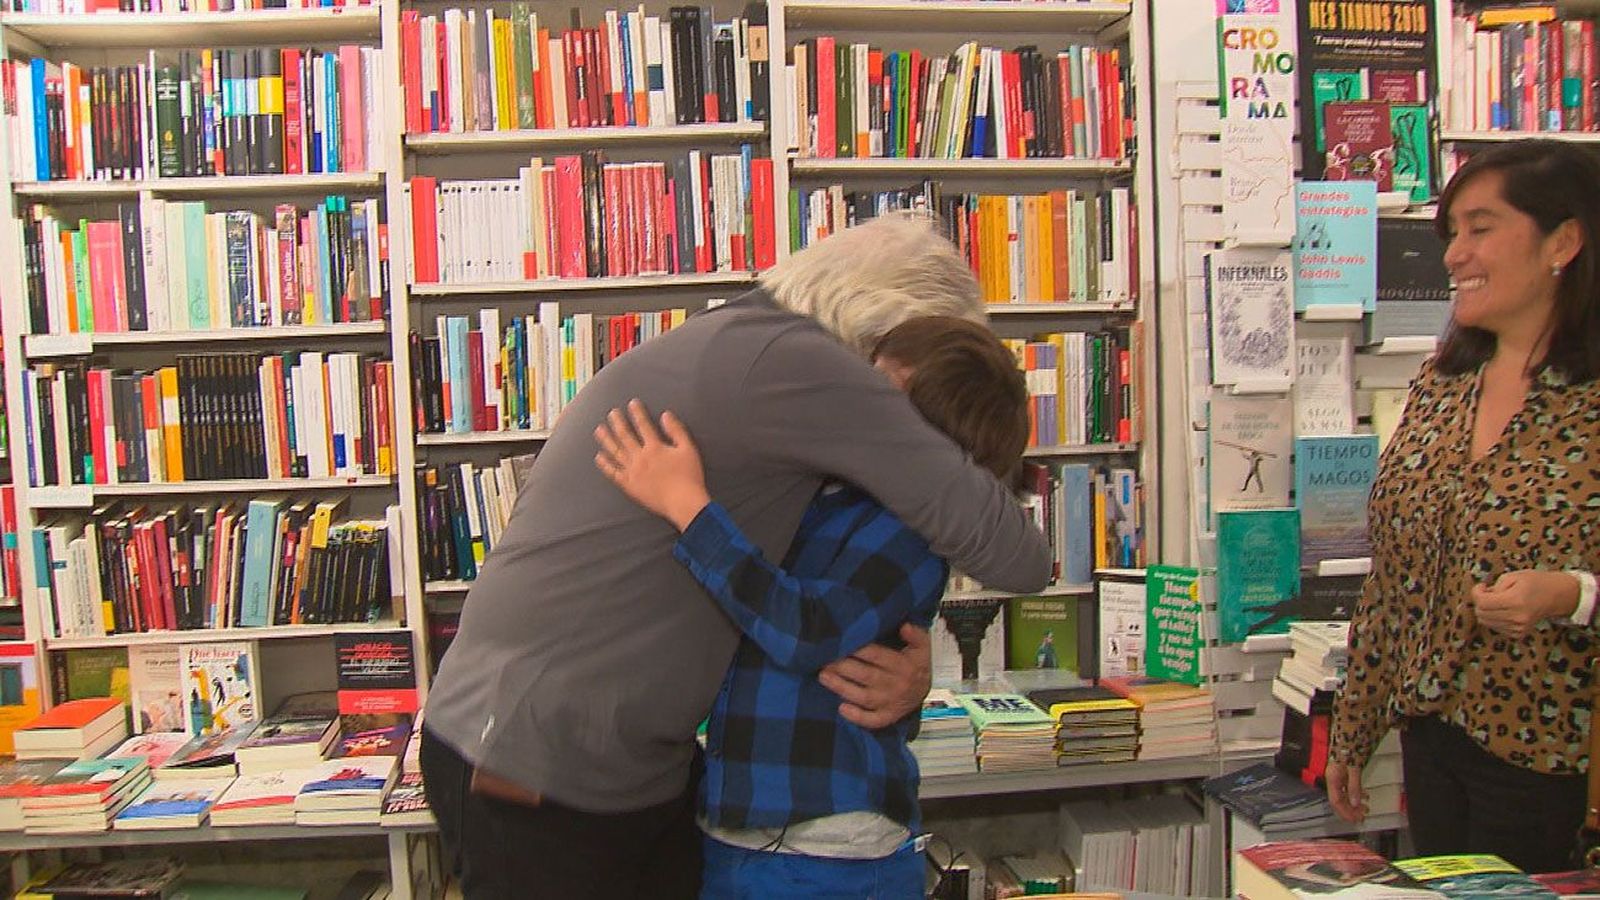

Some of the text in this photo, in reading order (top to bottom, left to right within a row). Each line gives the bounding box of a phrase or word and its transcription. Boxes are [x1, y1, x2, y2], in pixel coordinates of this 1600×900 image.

[1247, 102, 1288, 118] MA
[1300, 191, 1350, 201] Grandes
[1300, 206, 1368, 217] estrategias
[1301, 254, 1365, 264] John Lewis
[1217, 265, 1287, 282] INFERNALES
[1300, 269, 1341, 279] Gaddis
[1307, 444, 1372, 460] TIEMPO
[1309, 469, 1370, 486] MAGOS
[1176, 649, 1194, 660] que
